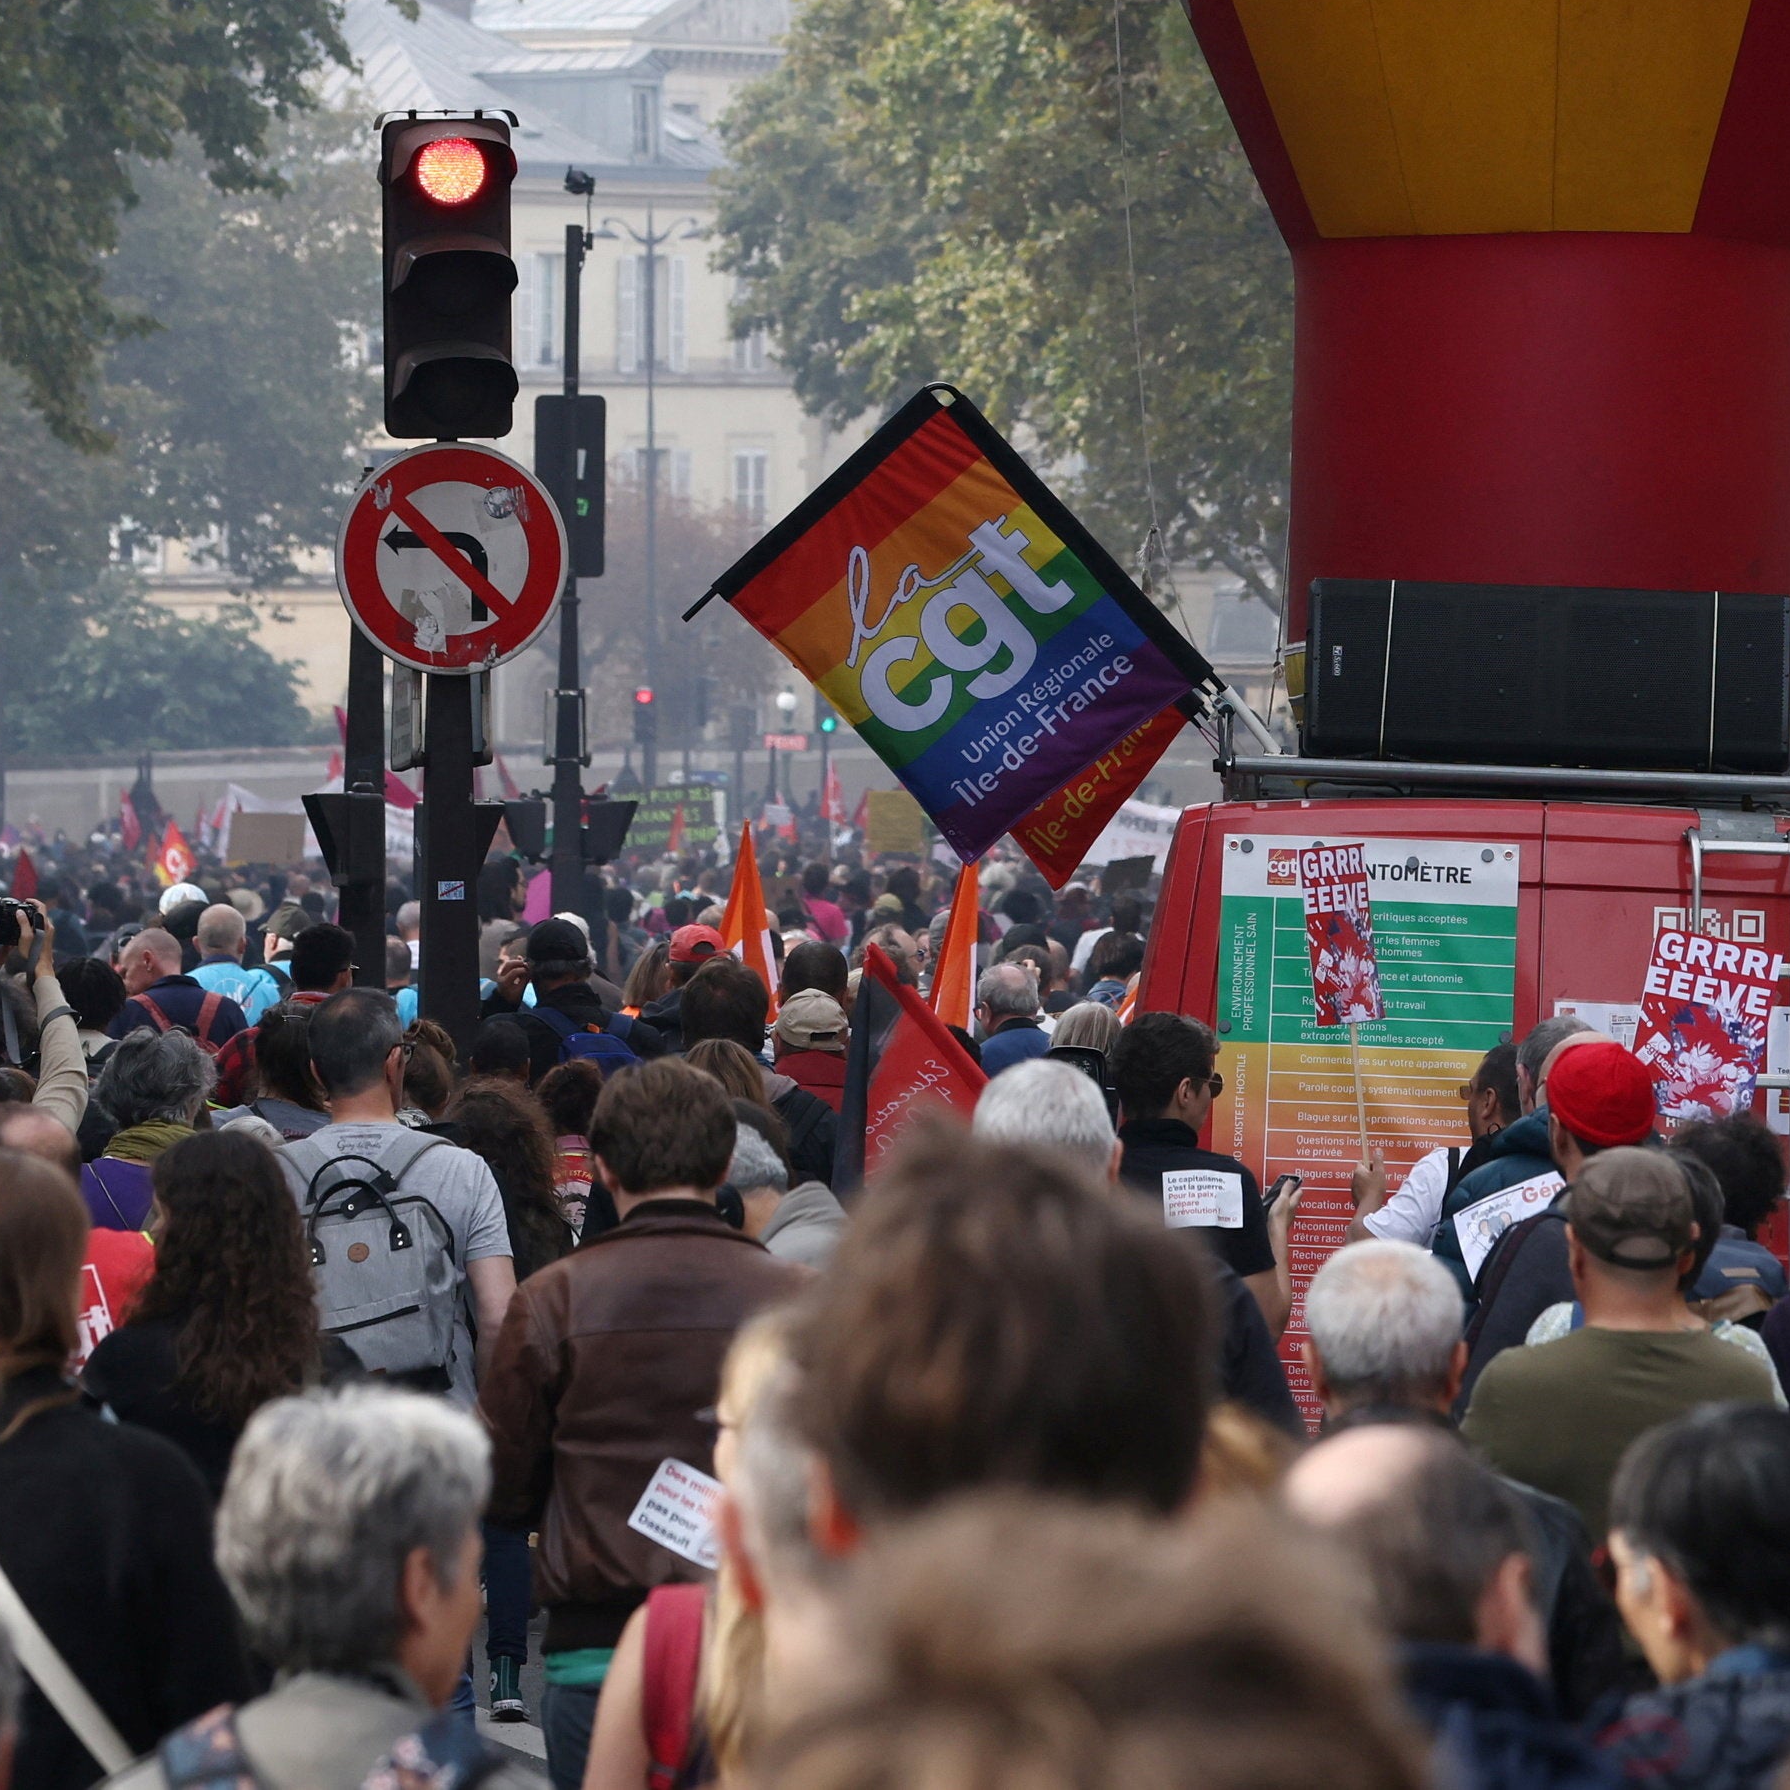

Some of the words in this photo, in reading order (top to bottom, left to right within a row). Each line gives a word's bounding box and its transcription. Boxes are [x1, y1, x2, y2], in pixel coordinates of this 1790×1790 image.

[845, 535, 985, 668] la
[860, 519, 1076, 732] cgt
[961, 710, 1023, 764] Union
[1016, 633, 1114, 713] Régionale
[950, 654, 1134, 808] Île-de-France
[1267, 860, 1298, 878] cgt
[1366, 862, 1473, 885] NTOMÈTRE
[1304, 877, 1369, 916] ÈÈÈVE
[1245, 912, 1257, 937] SAIN
[1373, 912, 1417, 924] critiques
[1418, 913, 1468, 925] acceptées
[1400, 936, 1441, 946] femmes
[1381, 947, 1423, 958] hommes
[1231, 924, 1246, 1018] ENVIRONNEMENT
[1401, 974, 1411, 983] et
[1411, 973, 1464, 984] autonomie
[1243, 940, 1256, 1031] PROFESSIONNEL
[1645, 958, 1772, 1018] ÈÈÈVE
[1383, 1000, 1394, 1010] du
[1395, 1000, 1426, 1010] travail
[1405, 1033, 1444, 1045] accepté
[1373, 1058, 1386, 1066] sur
[1388, 1058, 1414, 1067] votre
[1416, 1060, 1468, 1070] apparence
[1657, 1055, 1681, 1082] UGICT
[1236, 1054, 1247, 1092] HOSTILE
[1299, 1082, 1329, 1092] Parole
[1368, 1086, 1458, 1098] systématiquement
[1236, 1095, 1246, 1105] ET
[1297, 1112, 1327, 1124] Blague
[1329, 1115, 1345, 1123] sur
[1234, 1107, 1246, 1147] SEXISTE
[1296, 1135, 1344, 1146] Questions
[1397, 1140, 1411, 1148] sur
[1413, 1140, 1439, 1149] votre
[1296, 1147, 1311, 1156] vie
[1313, 1147, 1342, 1157] privée
[1167, 1176, 1177, 1184] Le
[1167, 1184, 1186, 1192] c'est
[1521, 1181, 1565, 1203] Gén
[1169, 1200, 1200, 1209] prépare
[1300, 1200, 1342, 1210] vocation
[1294, 1221, 1348, 1232] Mécontente
[1293, 1232, 1319, 1243] d'être
[1292, 1263, 1314, 1272] avec
[665, 1465, 687, 1485] Des
[646, 1498, 669, 1517] pas
[669, 1511, 699, 1533] pour
[638, 1513, 691, 1549] Dassault
